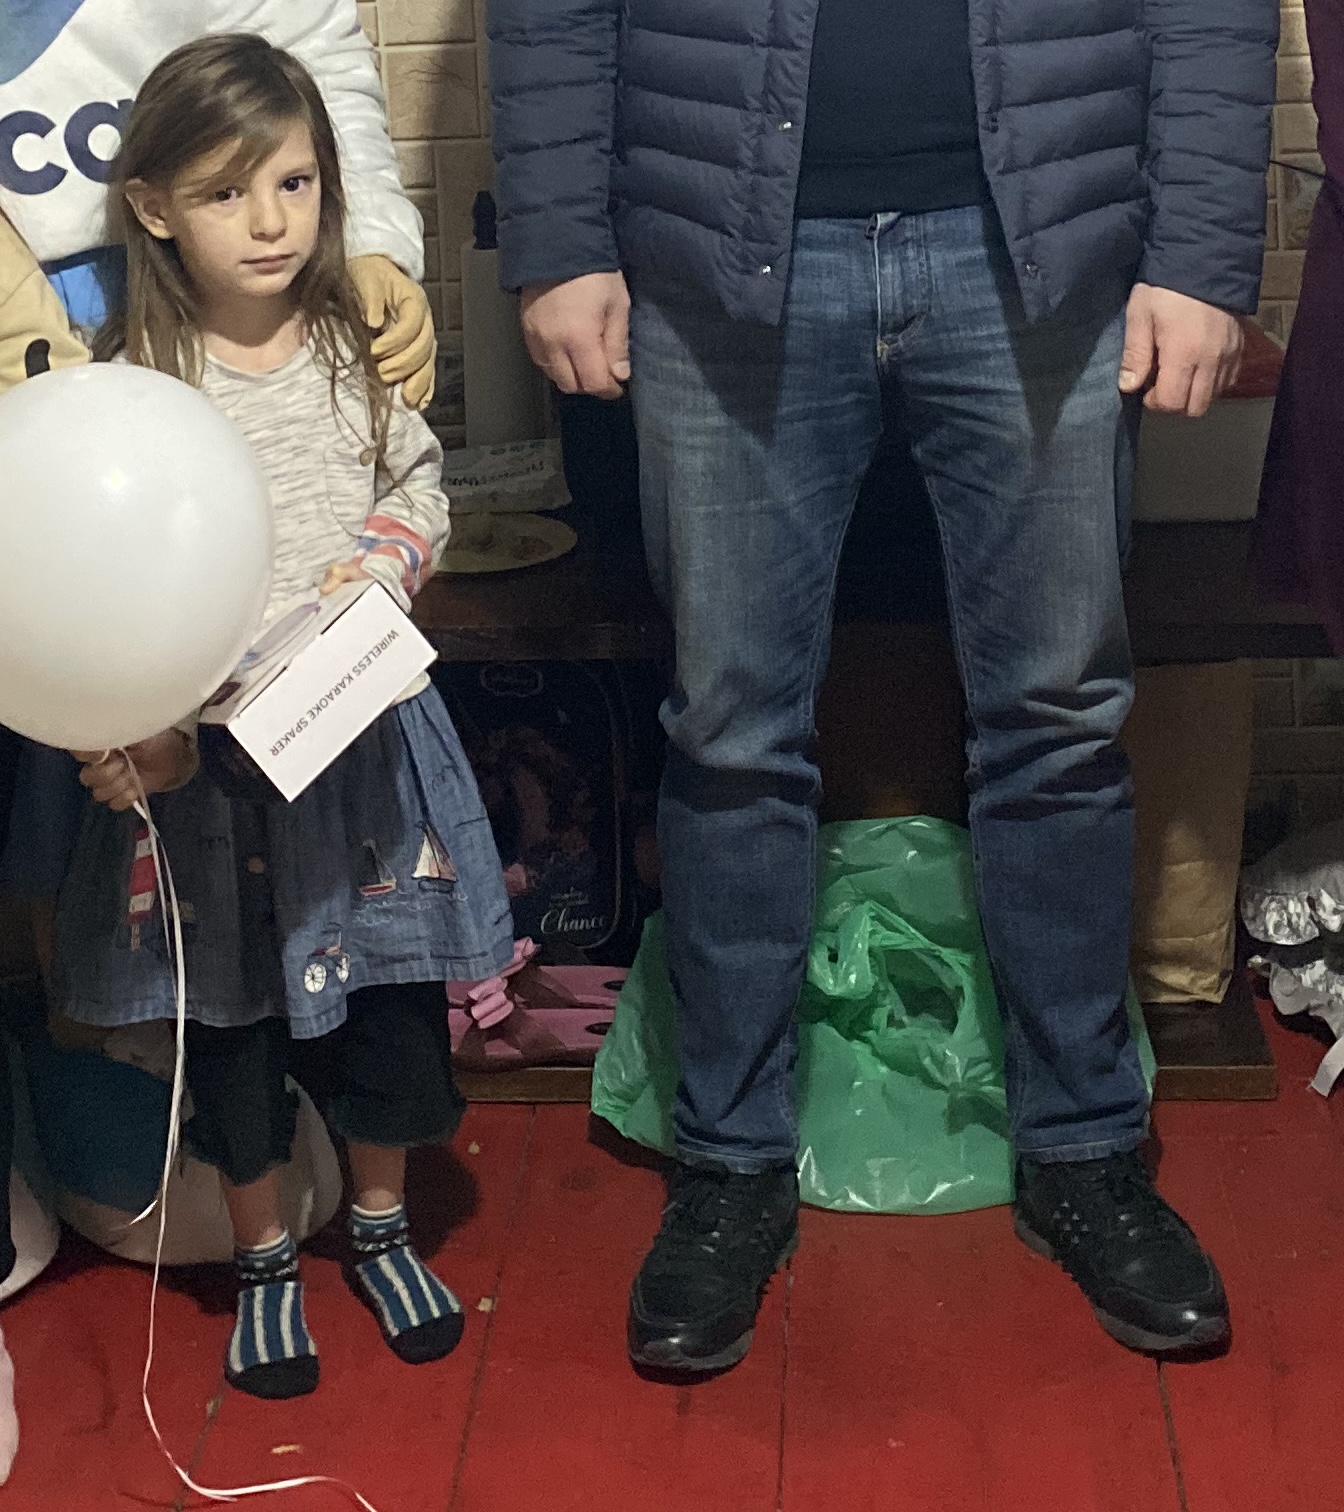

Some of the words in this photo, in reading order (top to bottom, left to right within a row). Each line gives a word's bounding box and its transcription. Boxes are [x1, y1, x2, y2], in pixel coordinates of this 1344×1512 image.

[352, 629, 400, 677] WIRELESS
[310, 673, 355, 721] KARAOKE
[270, 713, 310, 757] SPAKER
